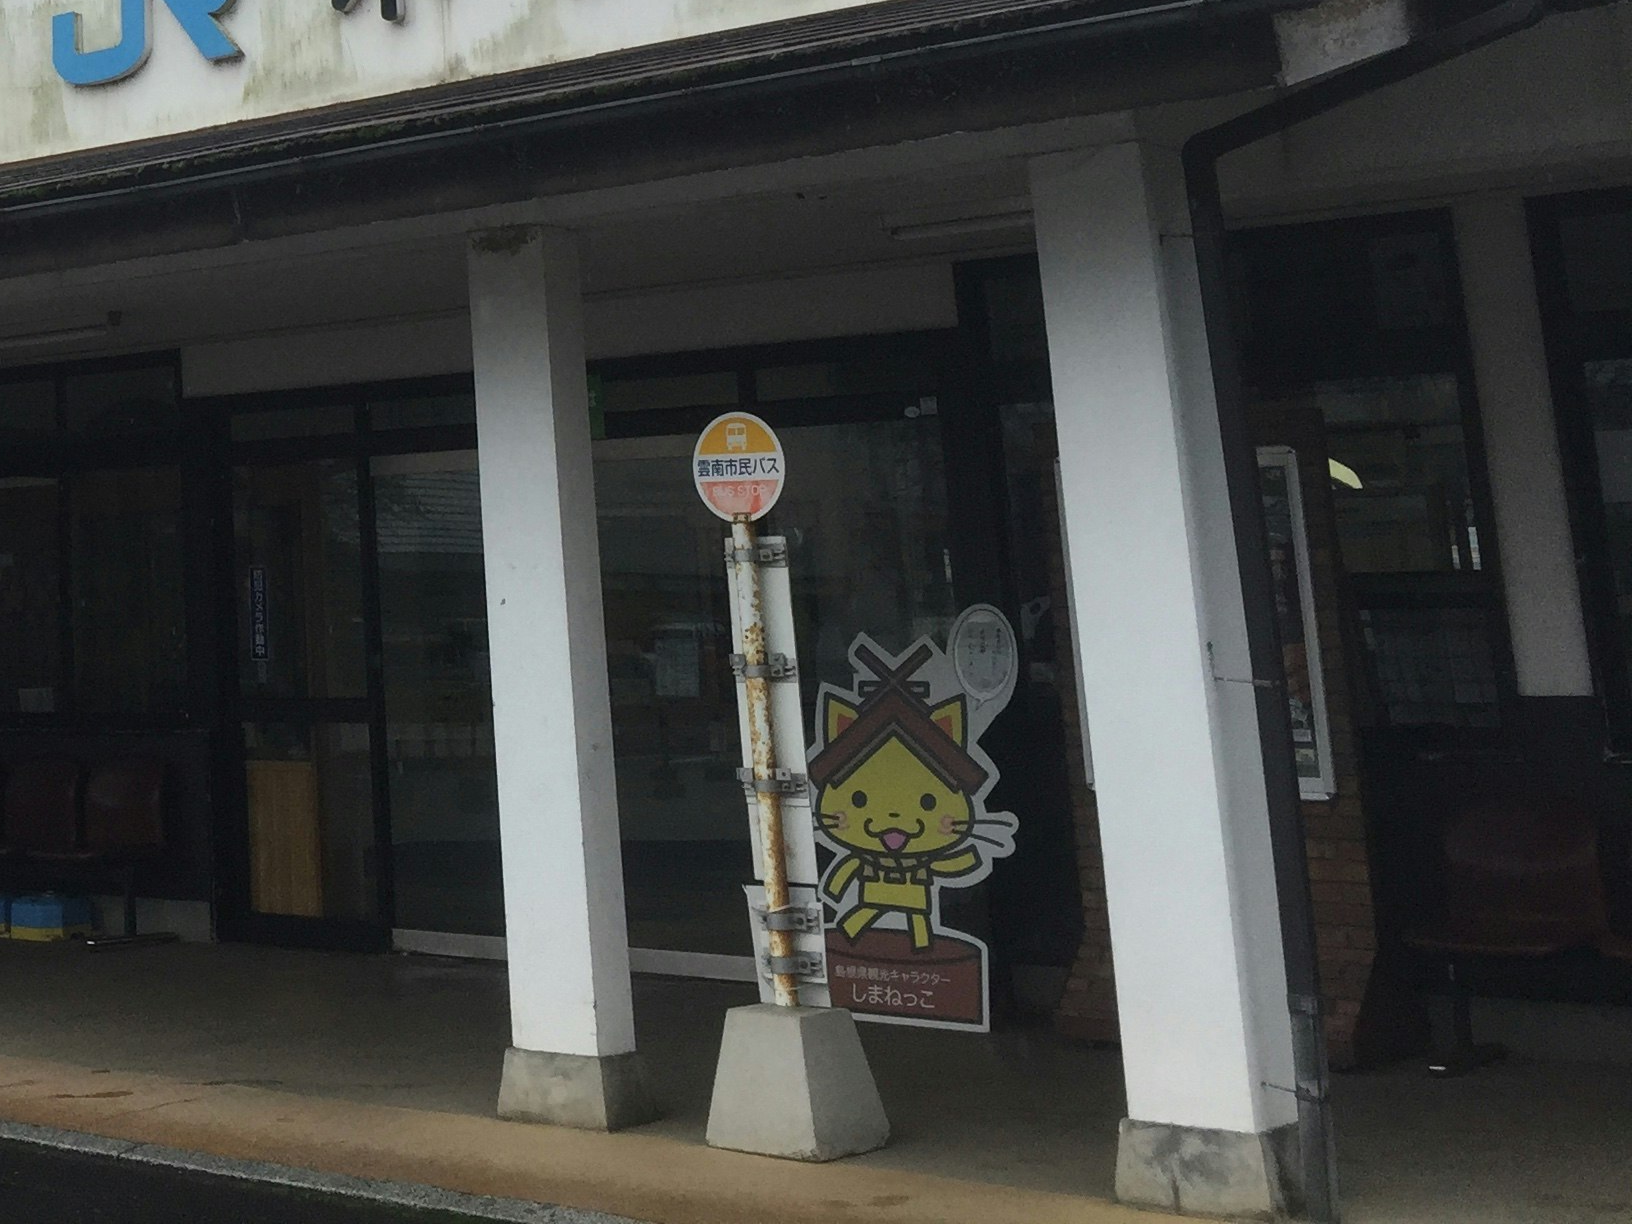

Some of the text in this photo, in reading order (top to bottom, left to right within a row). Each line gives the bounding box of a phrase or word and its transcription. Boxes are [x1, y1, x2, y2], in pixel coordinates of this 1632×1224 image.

[697, 457, 780, 478] 雲南市民バス
[712, 484, 768, 497] BUS STOP
[834, 964, 952, 986] 島根県観光キャラクター
[852, 982, 935, 1009] しまねっこ
